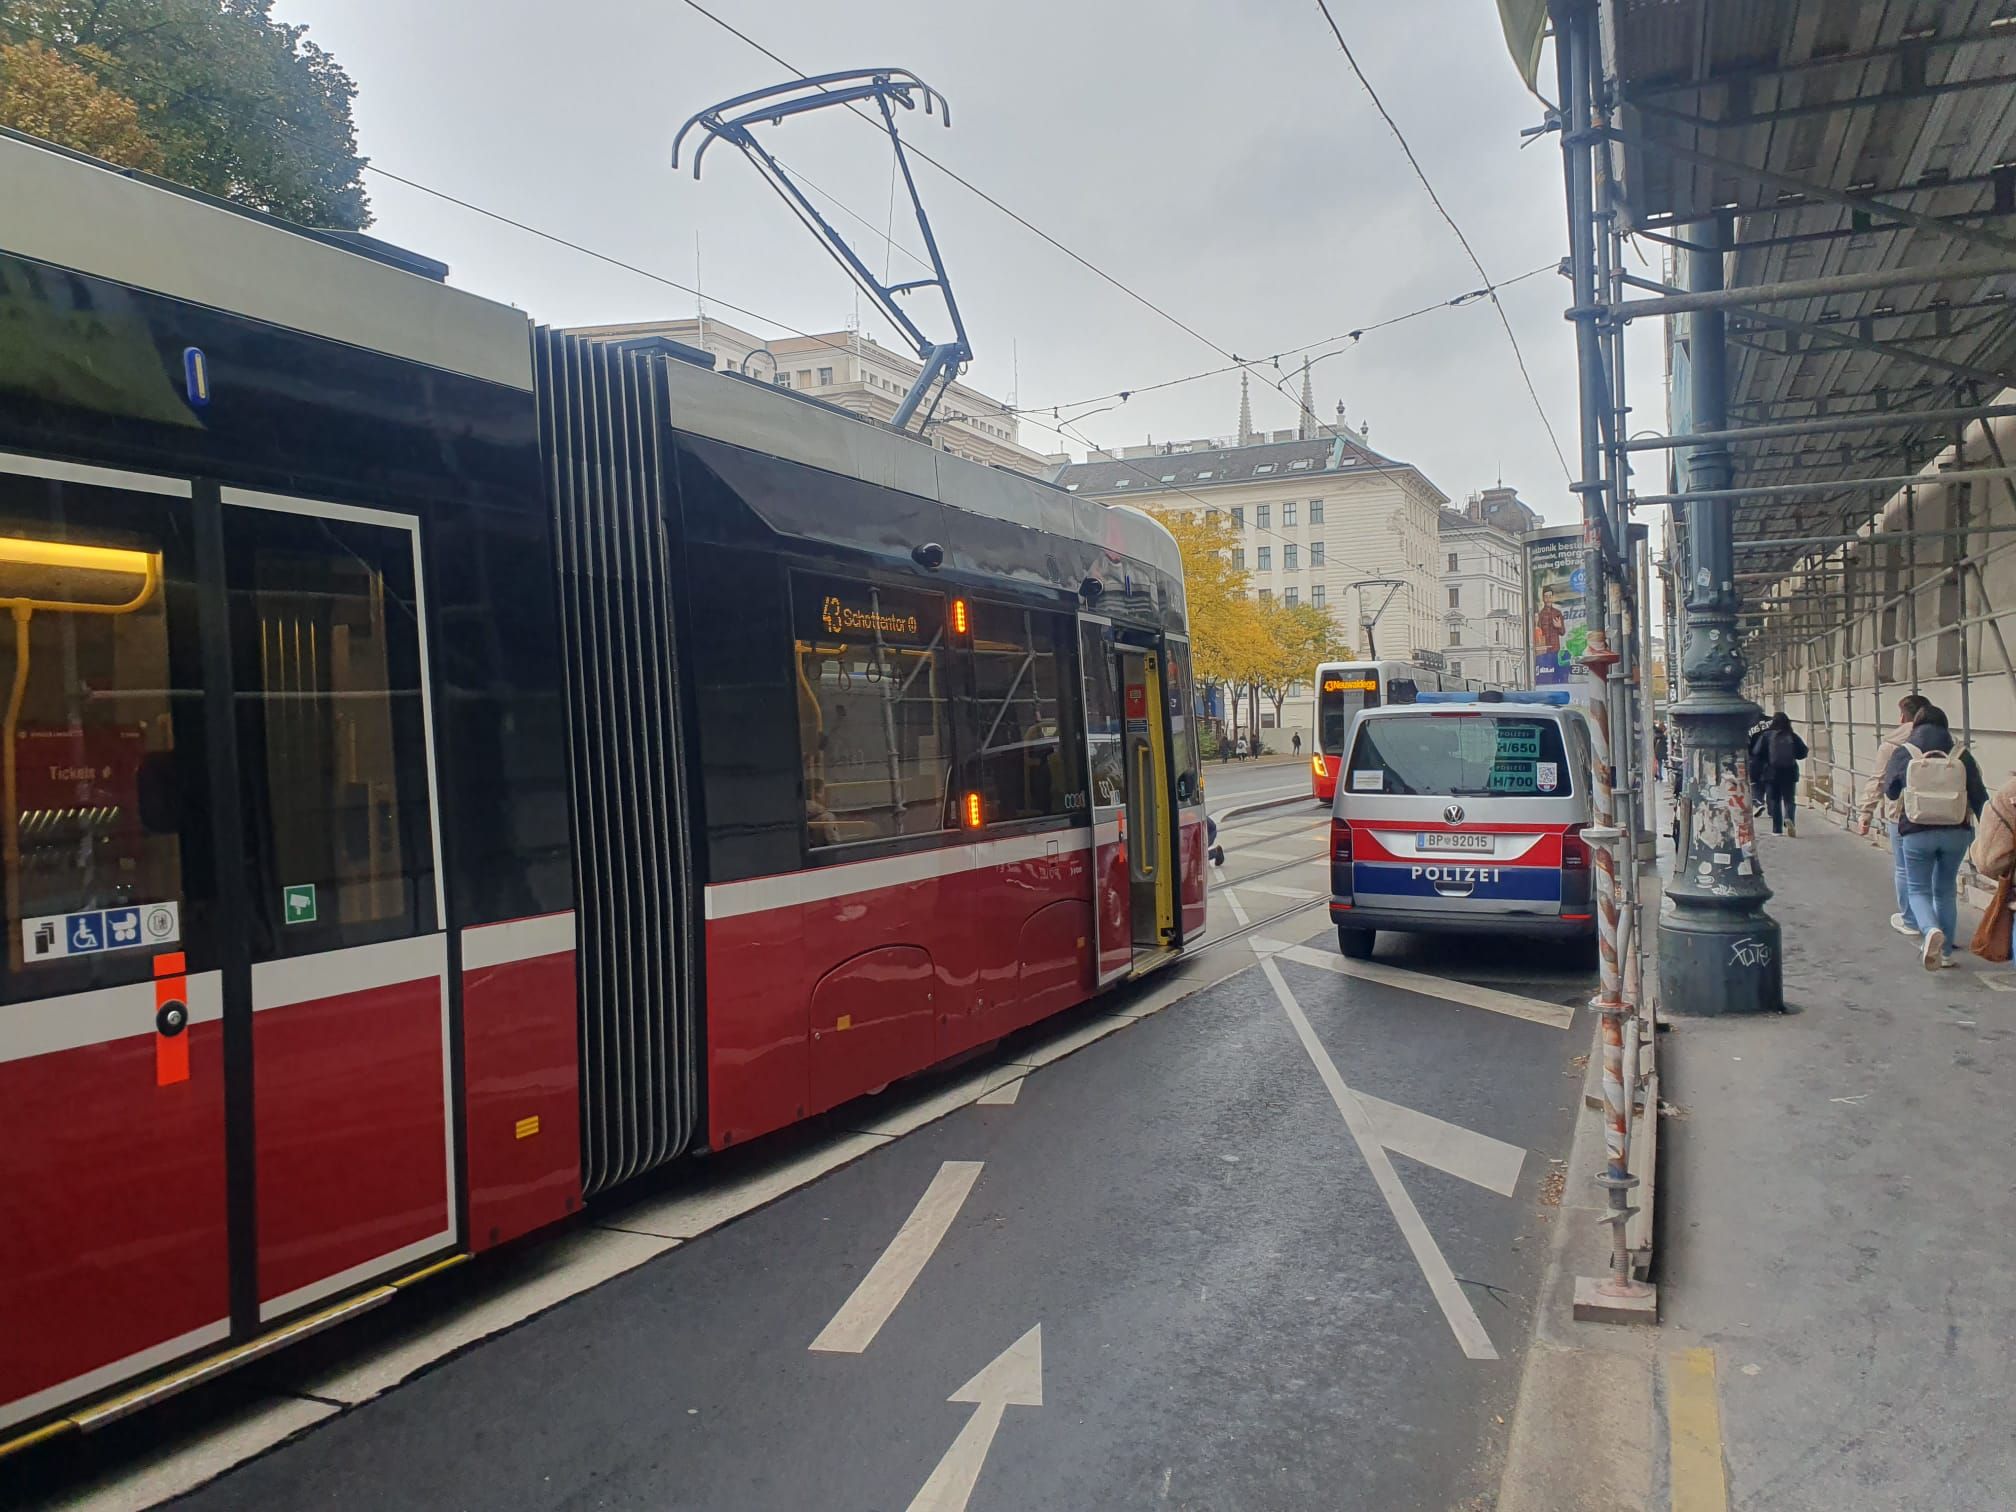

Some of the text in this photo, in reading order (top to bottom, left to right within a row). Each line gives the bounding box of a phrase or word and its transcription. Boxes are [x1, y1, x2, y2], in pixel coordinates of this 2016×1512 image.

[822, 595, 842, 633] 43
[843, 608, 906, 633] Schottentor
[1324, 679, 1377, 692] 43 Neuwaldegg
[1494, 776, 1533, 788] H/700
[1428, 834, 1488, 848] BP 92015
[1411, 866, 1499, 883] POLIZEI
